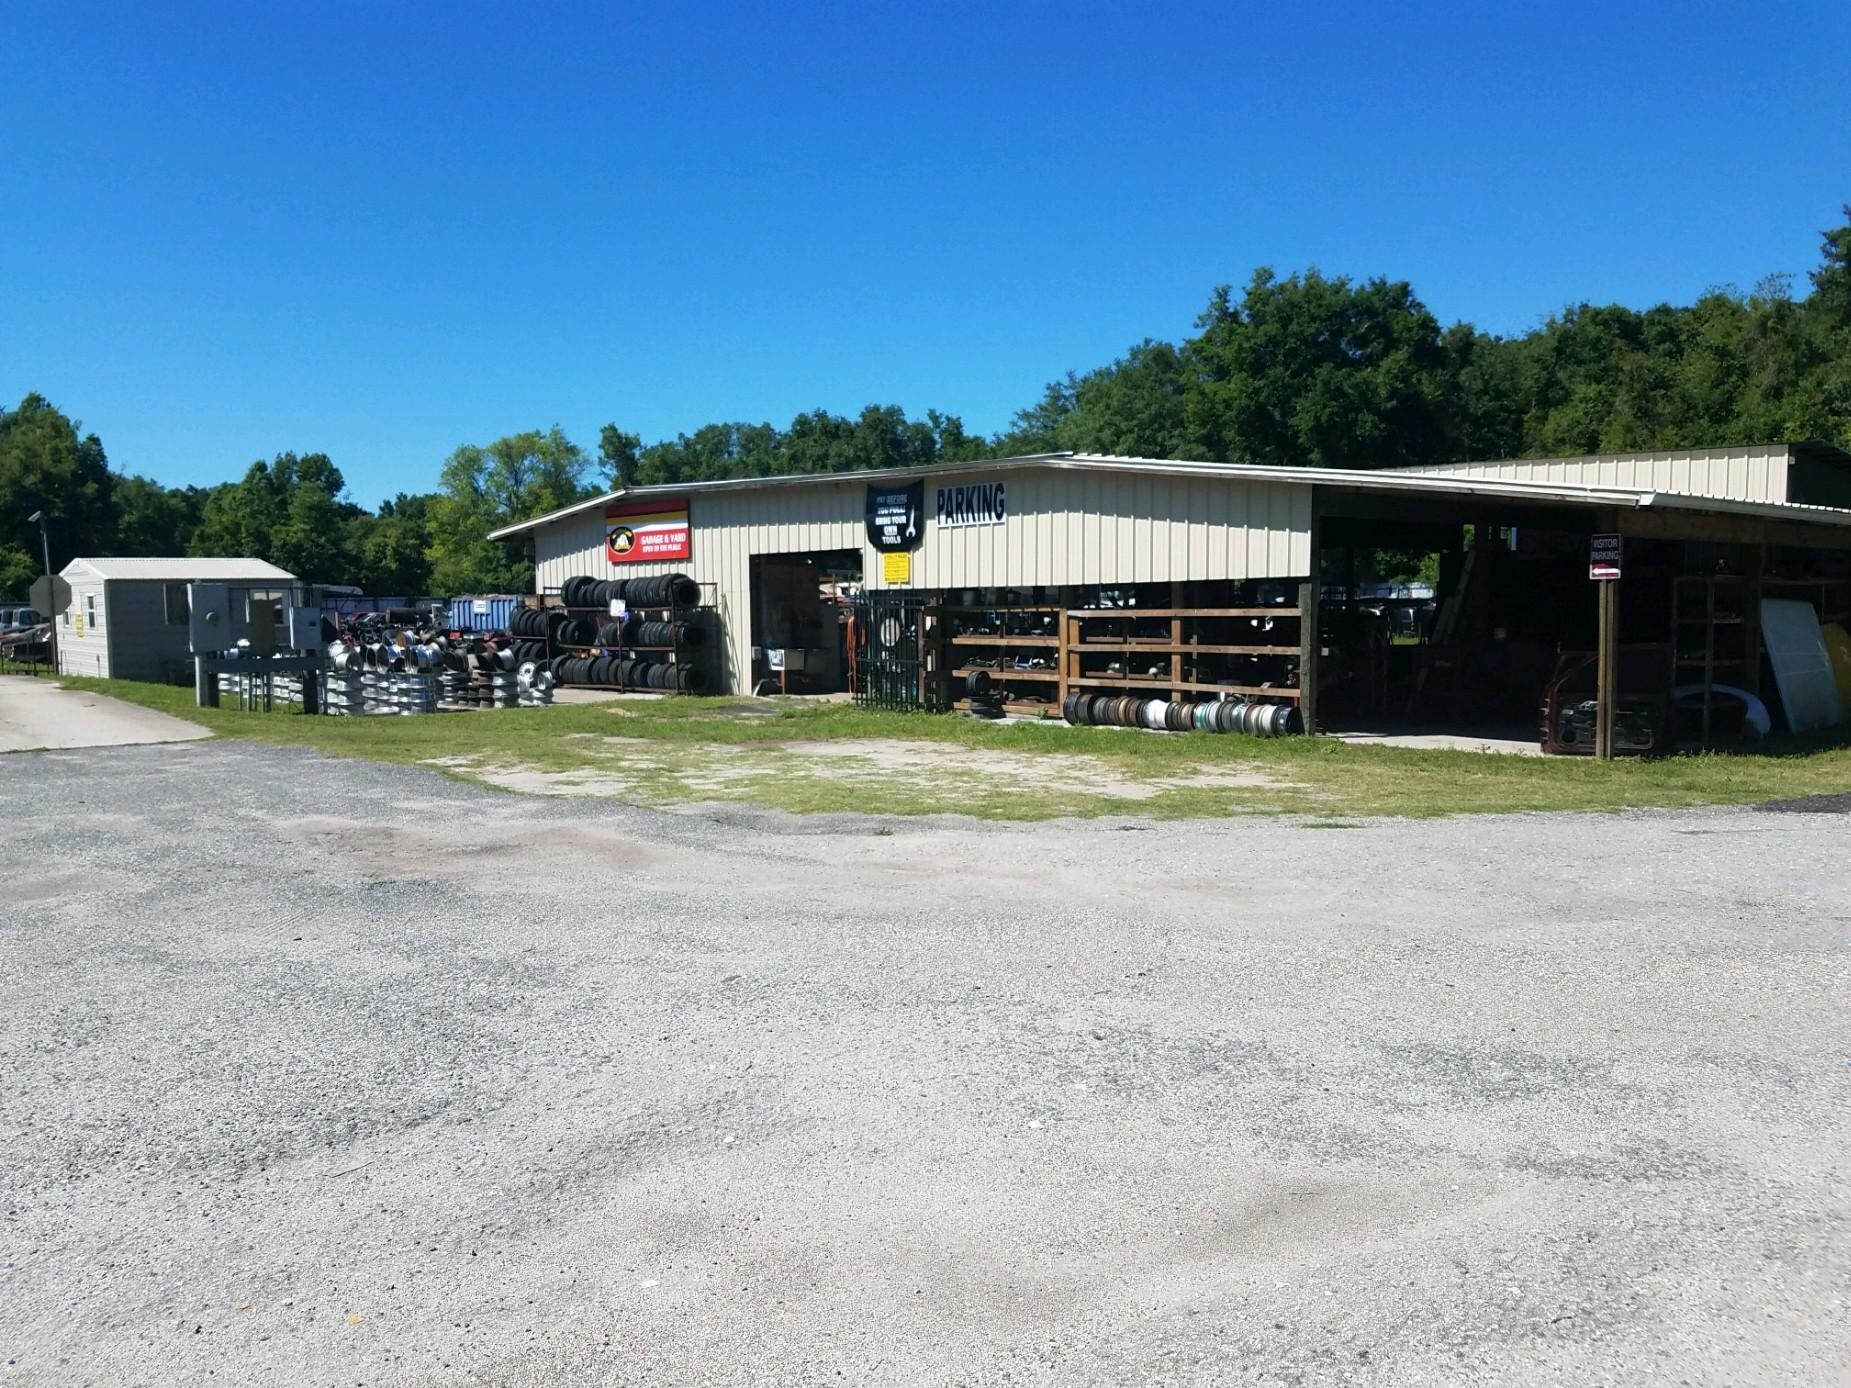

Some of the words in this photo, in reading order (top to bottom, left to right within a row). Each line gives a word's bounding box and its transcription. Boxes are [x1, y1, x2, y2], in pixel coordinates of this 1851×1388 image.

[937, 482, 1005, 525] PARKING
[891, 515, 907, 525] YOUR
[641, 535, 663, 545] GARAGE
[670, 532, 686, 543] YARD
[882, 535, 901, 544] TOOLS
[1592, 538, 1618, 549] VISITOR
[1591, 550, 1619, 561] PARKING
